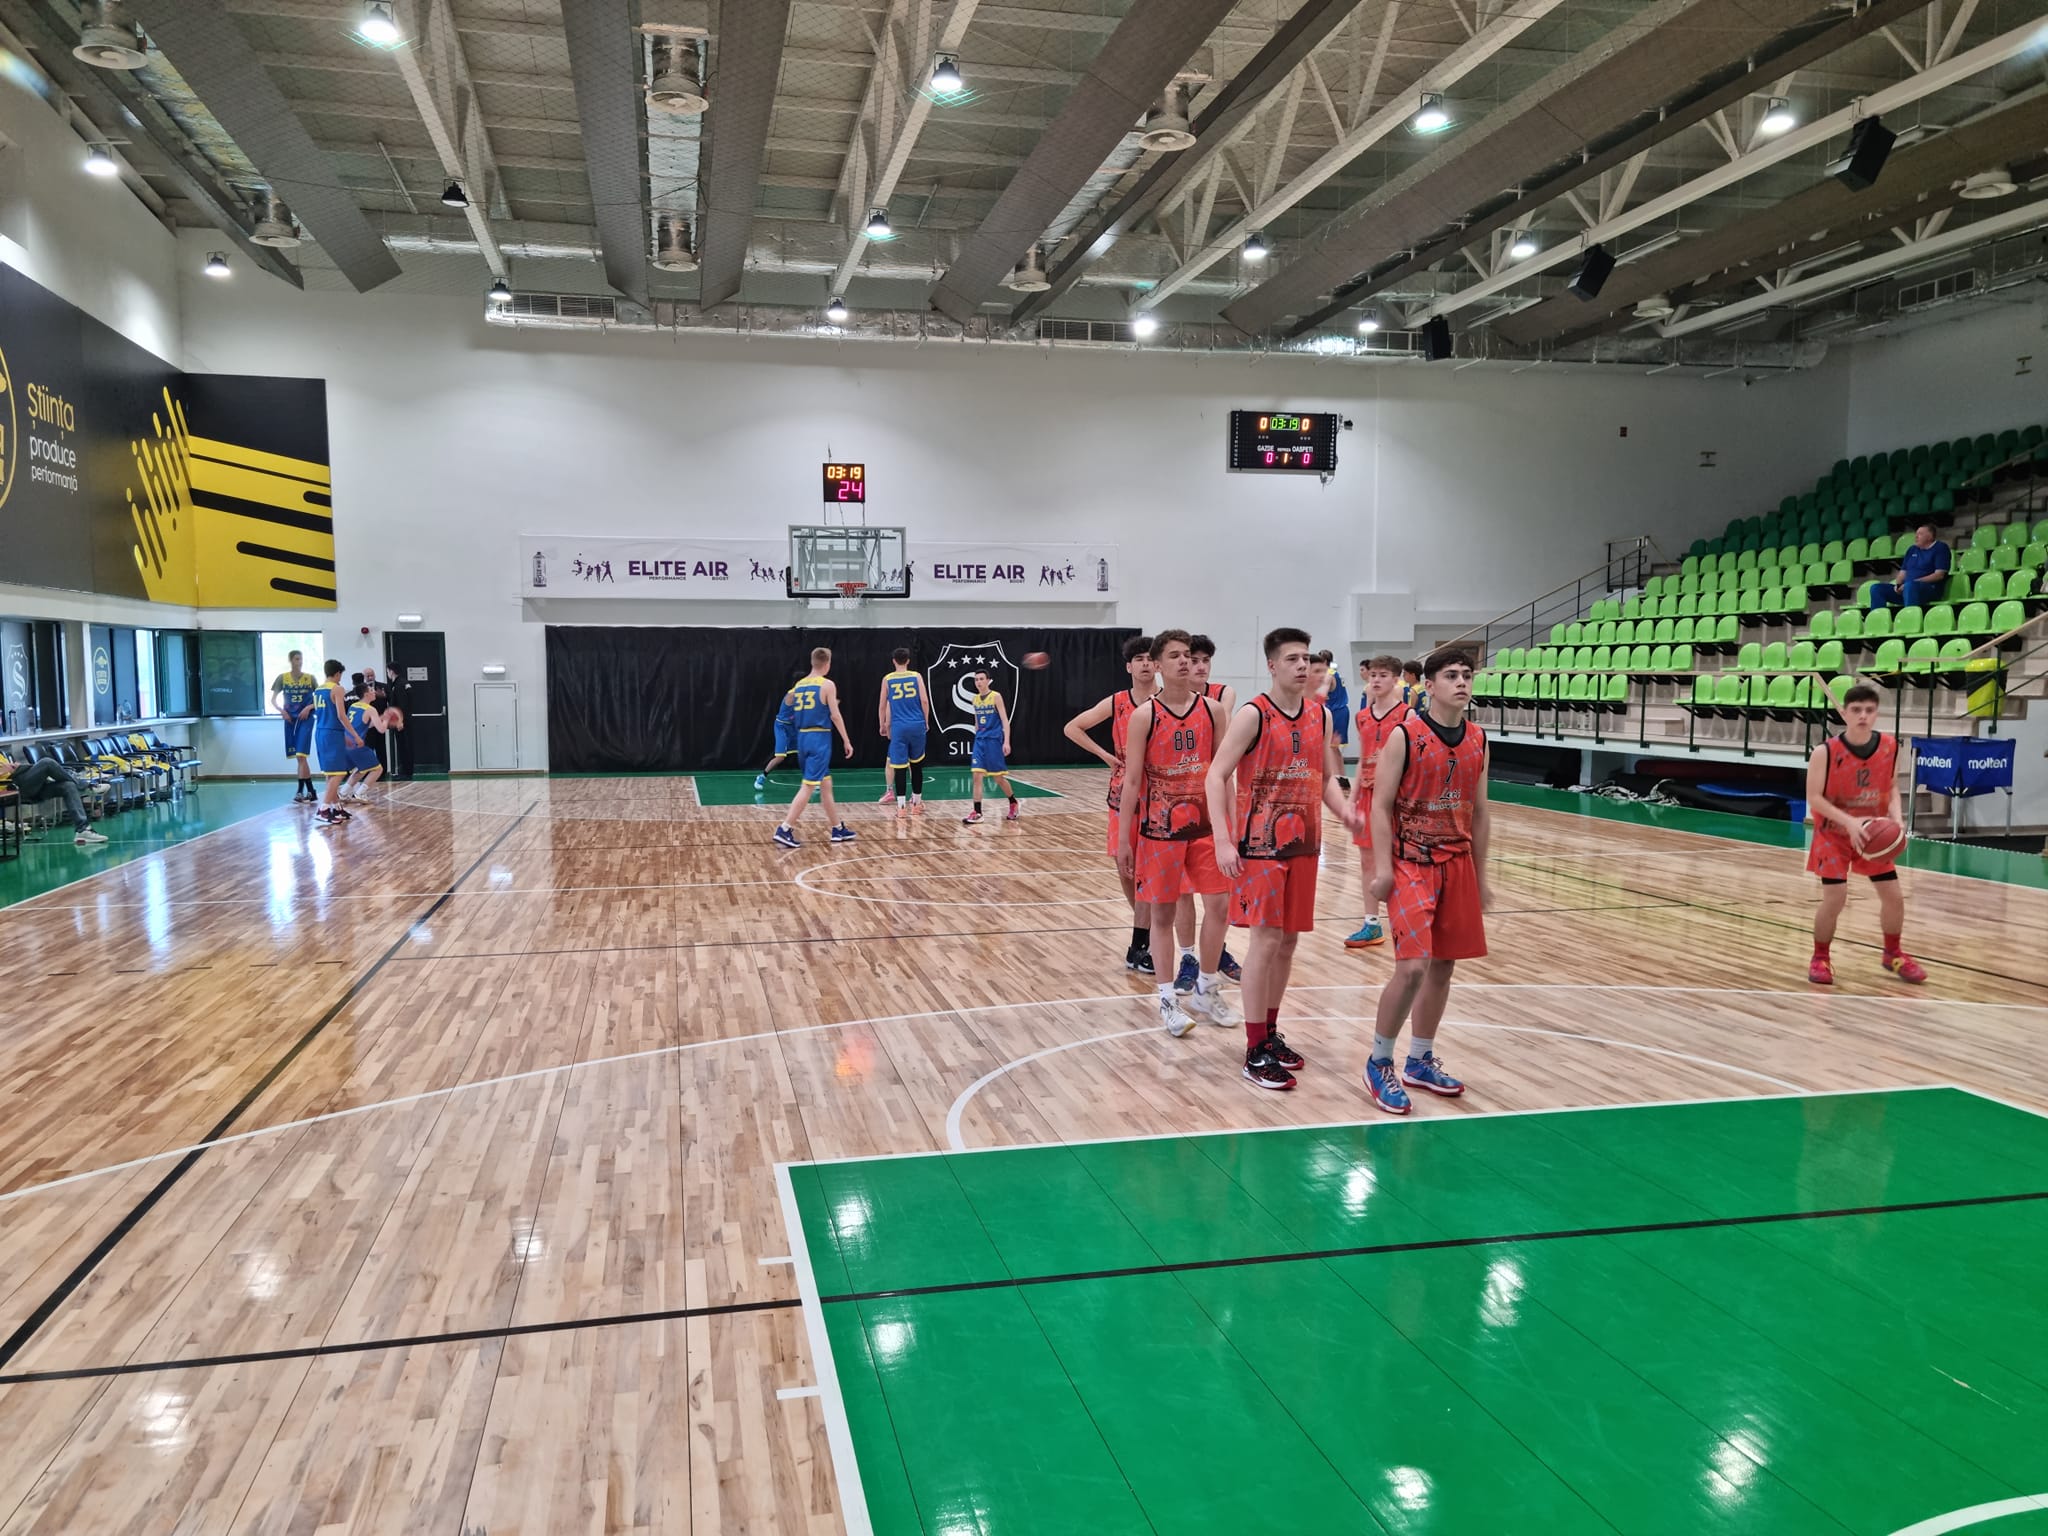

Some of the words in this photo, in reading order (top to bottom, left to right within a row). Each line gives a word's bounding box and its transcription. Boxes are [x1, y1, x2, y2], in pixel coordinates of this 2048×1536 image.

[1271, 418, 1298, 430] 03:19
[29, 435, 76, 468] produce
[1266, 452, 1273, 463] 0
[1303, 453, 1310, 464] 0
[827, 466, 862, 479] 03:19
[838, 481, 862, 499] 24
[628, 560, 686, 576] ELITE
[692, 561, 729, 576] AIR
[934, 564, 986, 579] ELITE
[992, 565, 1025, 579] AIR
[890, 682, 917, 700] 35
[794, 691, 816, 711] 33
[949, 741, 974, 755] SIL
[1174, 729, 1196, 751] 88
[1917, 756, 1952, 768] molten
[1968, 757, 2008, 769] molten
[1444, 759, 1457, 784] 7
[1856, 768, 1871, 787] 12
